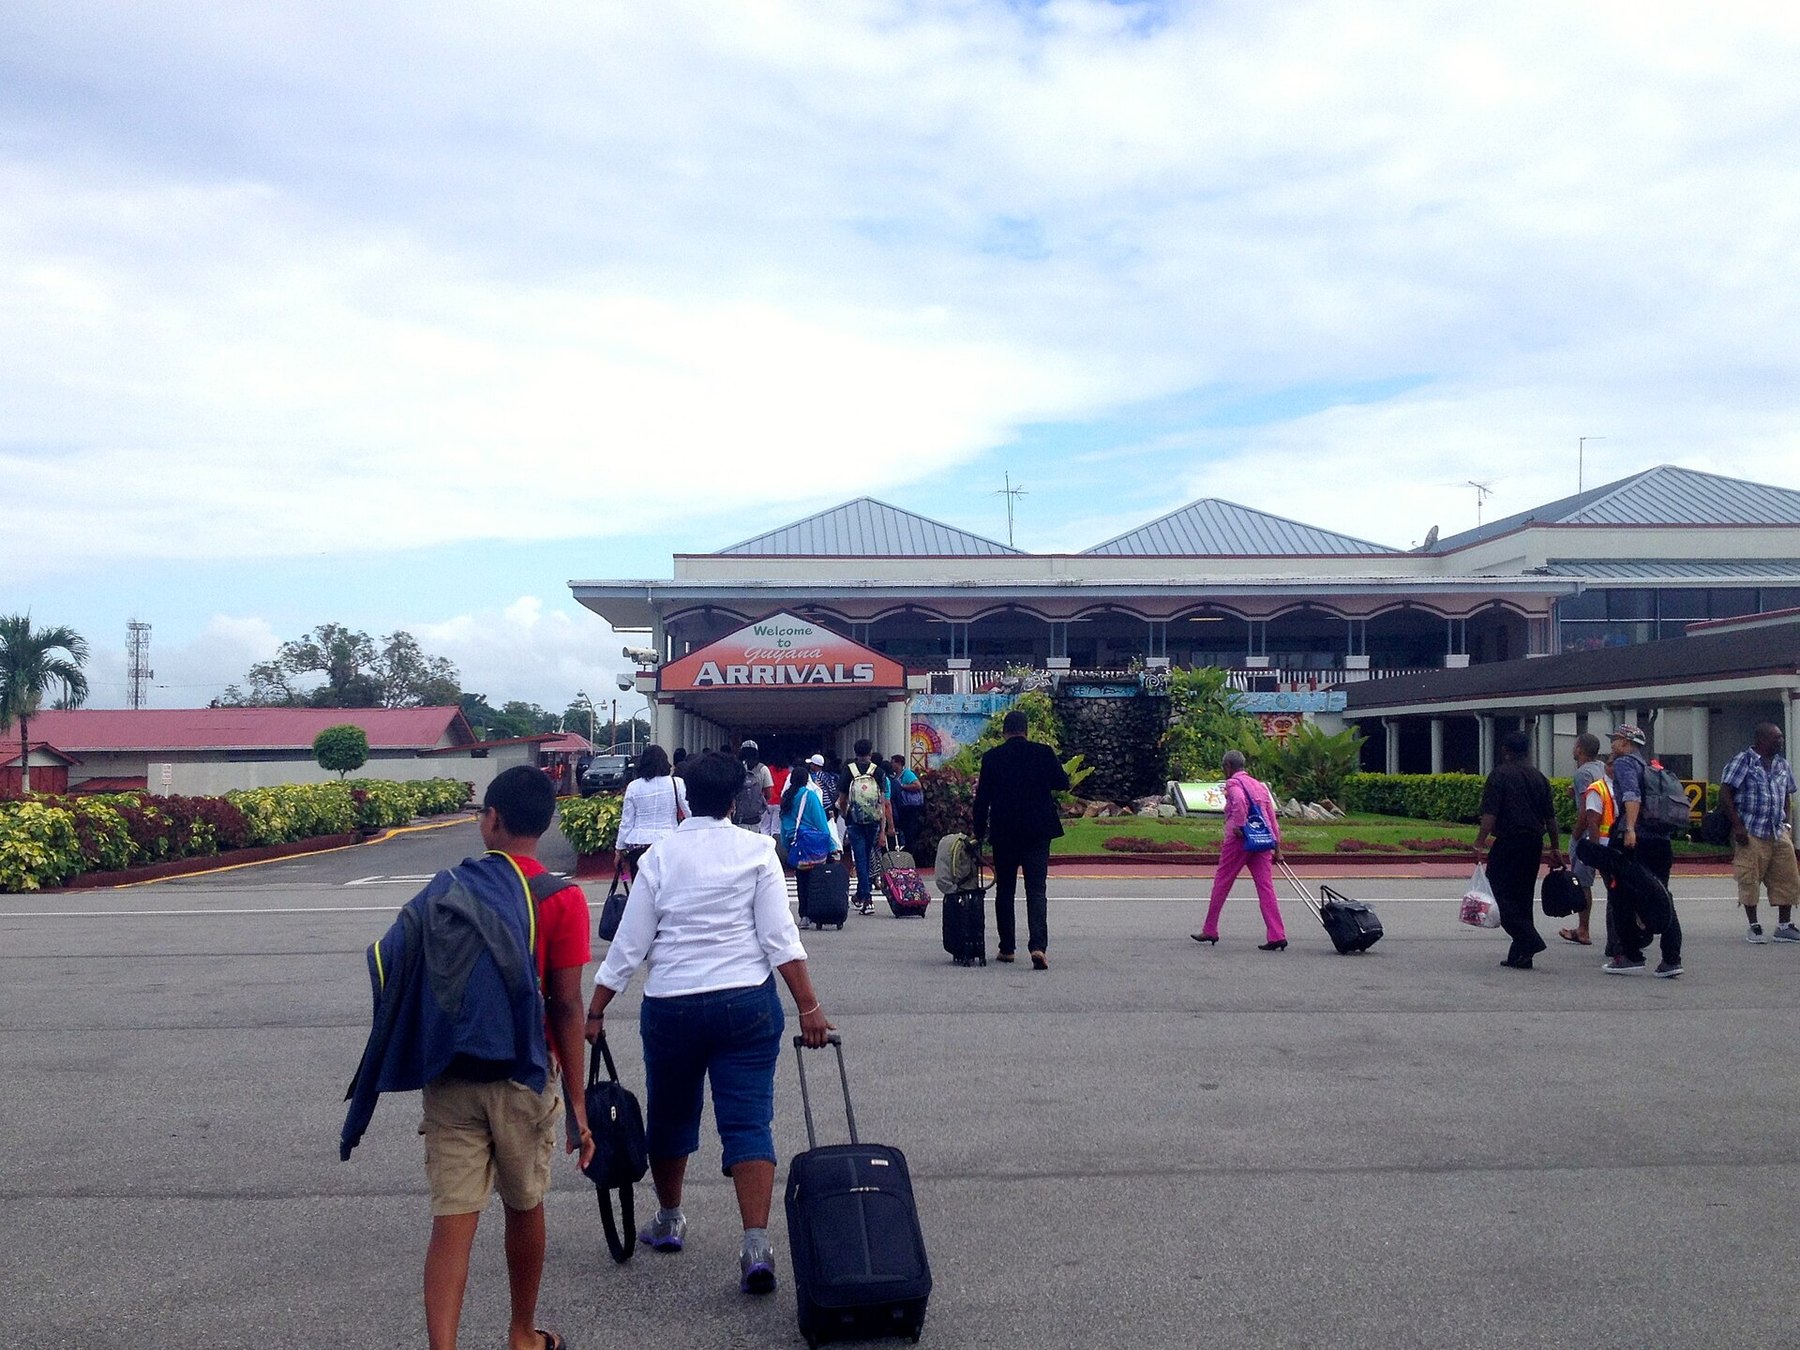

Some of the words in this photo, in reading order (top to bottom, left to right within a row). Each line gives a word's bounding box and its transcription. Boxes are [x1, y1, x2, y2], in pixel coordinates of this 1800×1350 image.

[753, 625, 813, 636] Welcome
[777, 638, 791, 648] to
[744, 647, 823, 664] Guyana
[692, 661, 874, 686] ARRIVALS
[1684, 784, 1702, 817] 2
